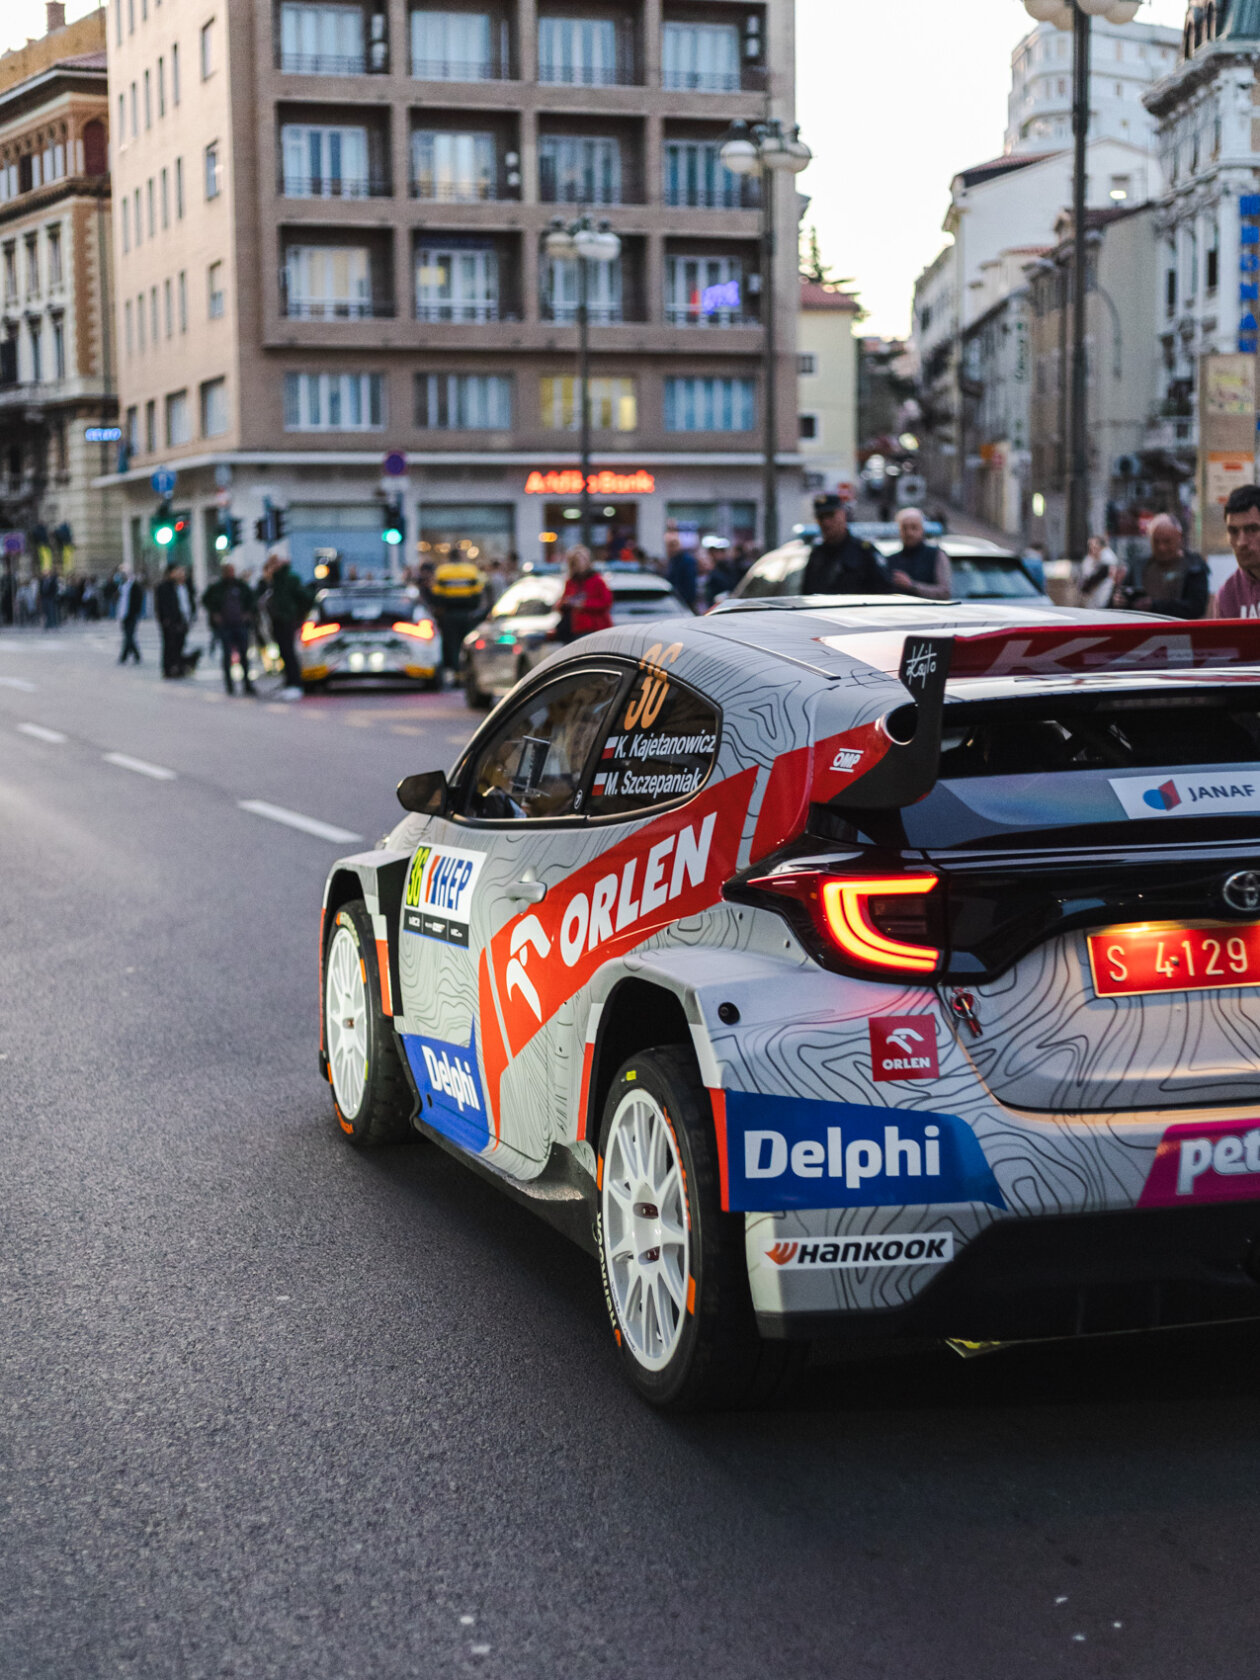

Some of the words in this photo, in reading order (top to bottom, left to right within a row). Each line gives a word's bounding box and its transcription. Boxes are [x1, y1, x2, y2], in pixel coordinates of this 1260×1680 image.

[614, 735, 629, 759] K.
[629, 729, 716, 762] Kajetanowicz
[832, 751, 861, 769] OMP
[604, 772, 619, 795] M.
[621, 768, 702, 798] Szczepaniak
[1188, 785, 1255, 801] JANAF
[438, 856, 473, 911] HEP
[560, 812, 717, 967] ORLEN
[1107, 945, 1128, 982] S
[1156, 937, 1248, 978] 4129
[421, 1045, 480, 1112] Delphi
[882, 1057, 931, 1070] ORLEN
[744, 1125, 940, 1189] Delphi
